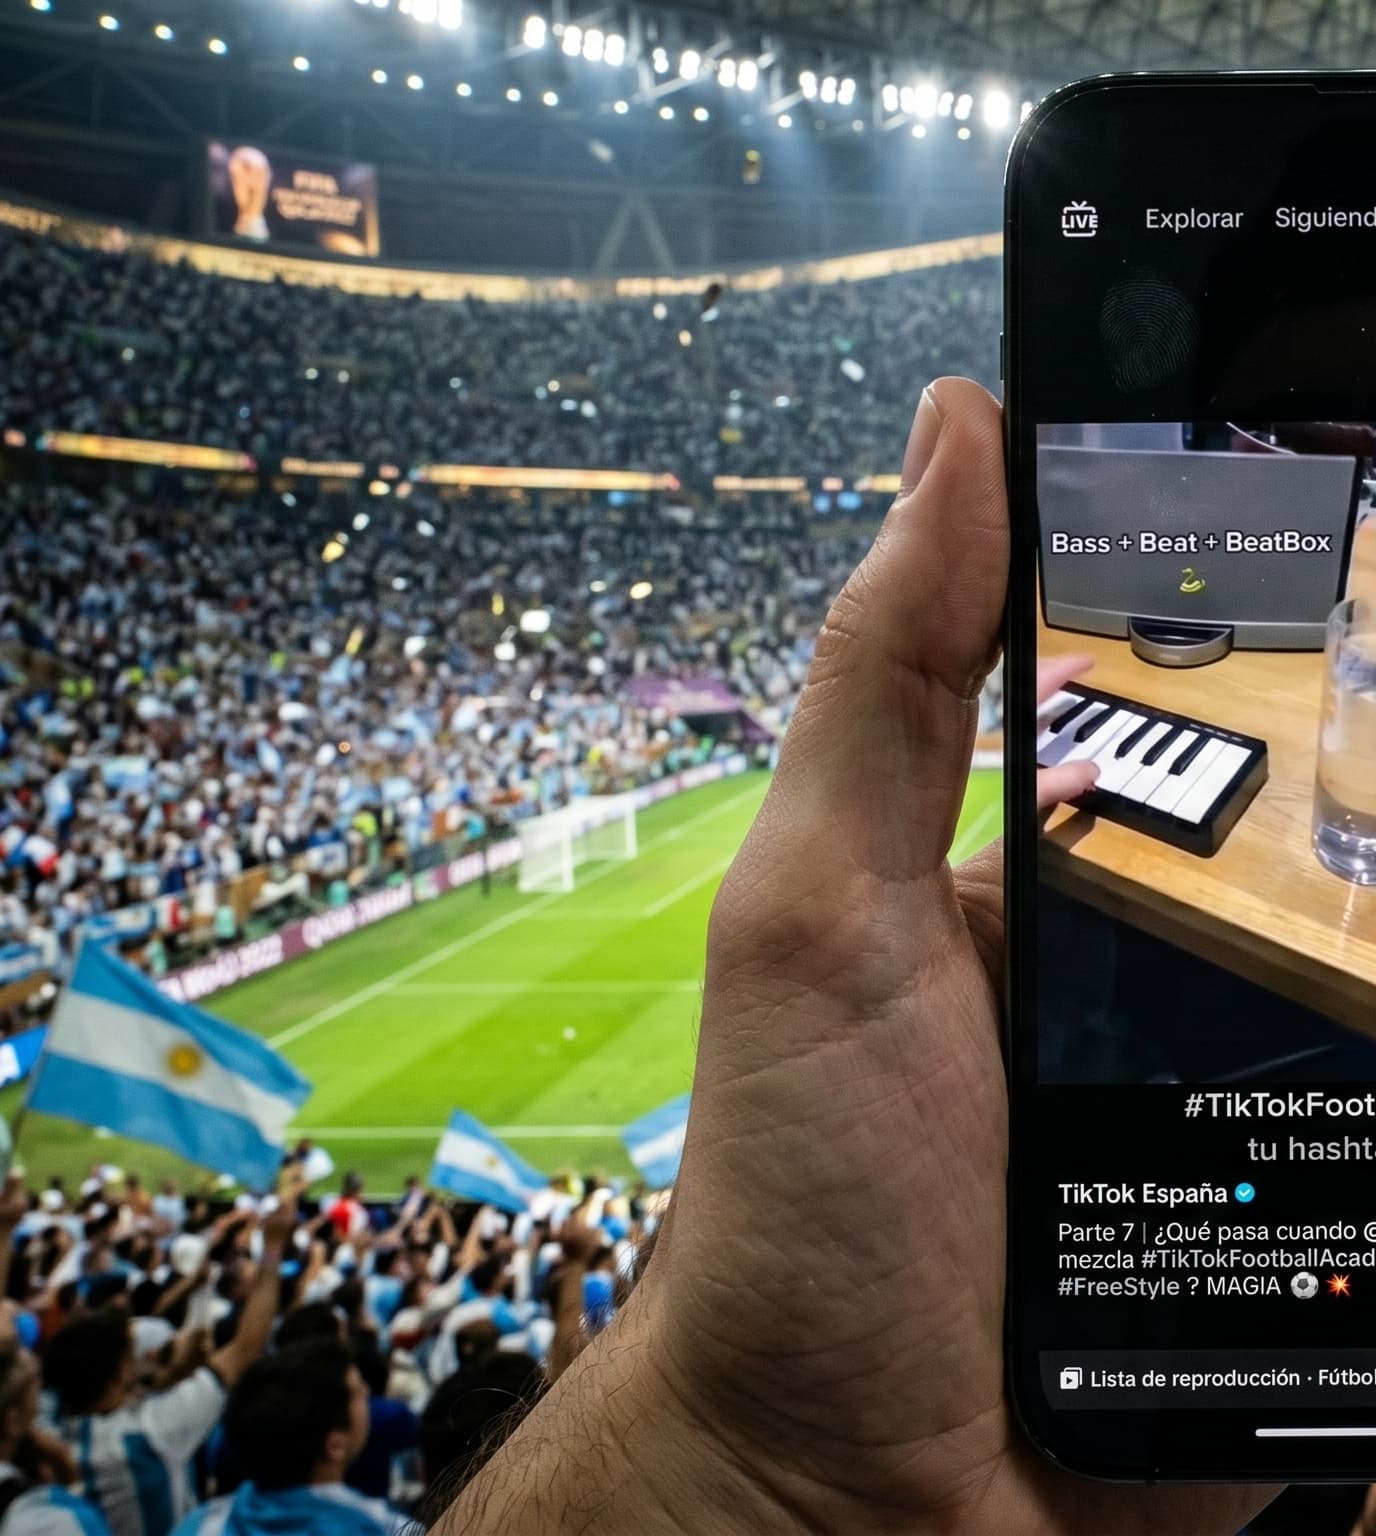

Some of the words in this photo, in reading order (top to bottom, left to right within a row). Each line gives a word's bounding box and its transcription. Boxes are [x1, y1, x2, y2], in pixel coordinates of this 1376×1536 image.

[1062, 214, 1098, 229] LIVE
[1146, 207, 1243, 234] Explorar
[1052, 533, 1111, 553] Bass
[1140, 532, 1198, 552] Beat
[1226, 531, 1331, 552] BeatBox
[1247, 1137, 1277, 1161] tu
[1058, 1183, 1136, 1204] TikTok
[1142, 1182, 1228, 1209] España
[1058, 1222, 1116, 1242] Parte
[1121, 1222, 1135, 1242] 7
[1154, 1220, 1211, 1246] ¿Qué
[1218, 1225, 1269, 1247] pasa
[1276, 1220, 1357, 1241] cuando
[1058, 1249, 1135, 1270] mezcla
[1058, 1276, 1180, 1300] #FreeStyle
[1186, 1276, 1200, 1296] ?
[1207, 1275, 1282, 1296] MAGIA
[1091, 1370, 1136, 1388] Lista
[1141, 1369, 1167, 1387] de
[1172, 1367, 1300, 1391] reproducción
